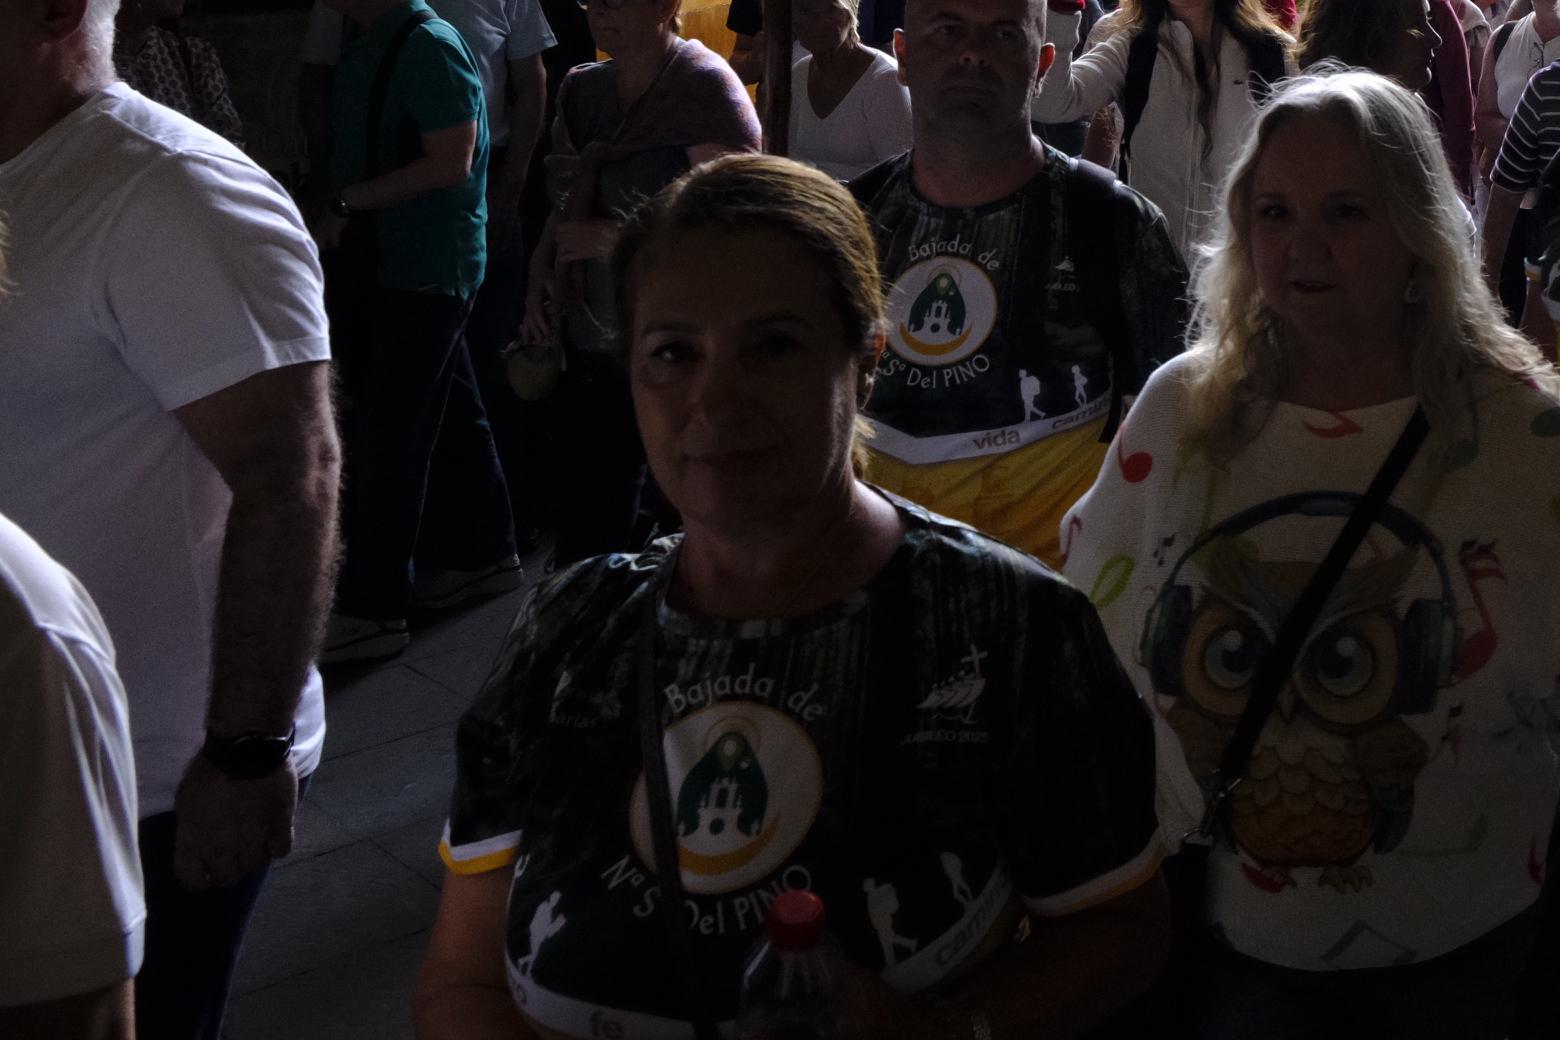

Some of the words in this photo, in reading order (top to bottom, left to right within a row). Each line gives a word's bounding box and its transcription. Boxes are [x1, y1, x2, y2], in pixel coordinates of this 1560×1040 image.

[907, 233, 973, 262] Bajada
[977, 248, 1000, 271] de
[906, 371, 937, 389] Del
[943, 354, 990, 388] PINO
[972, 429, 1021, 450] vida
[664, 661, 777, 712] Bajada
[787, 681, 825, 722] de
